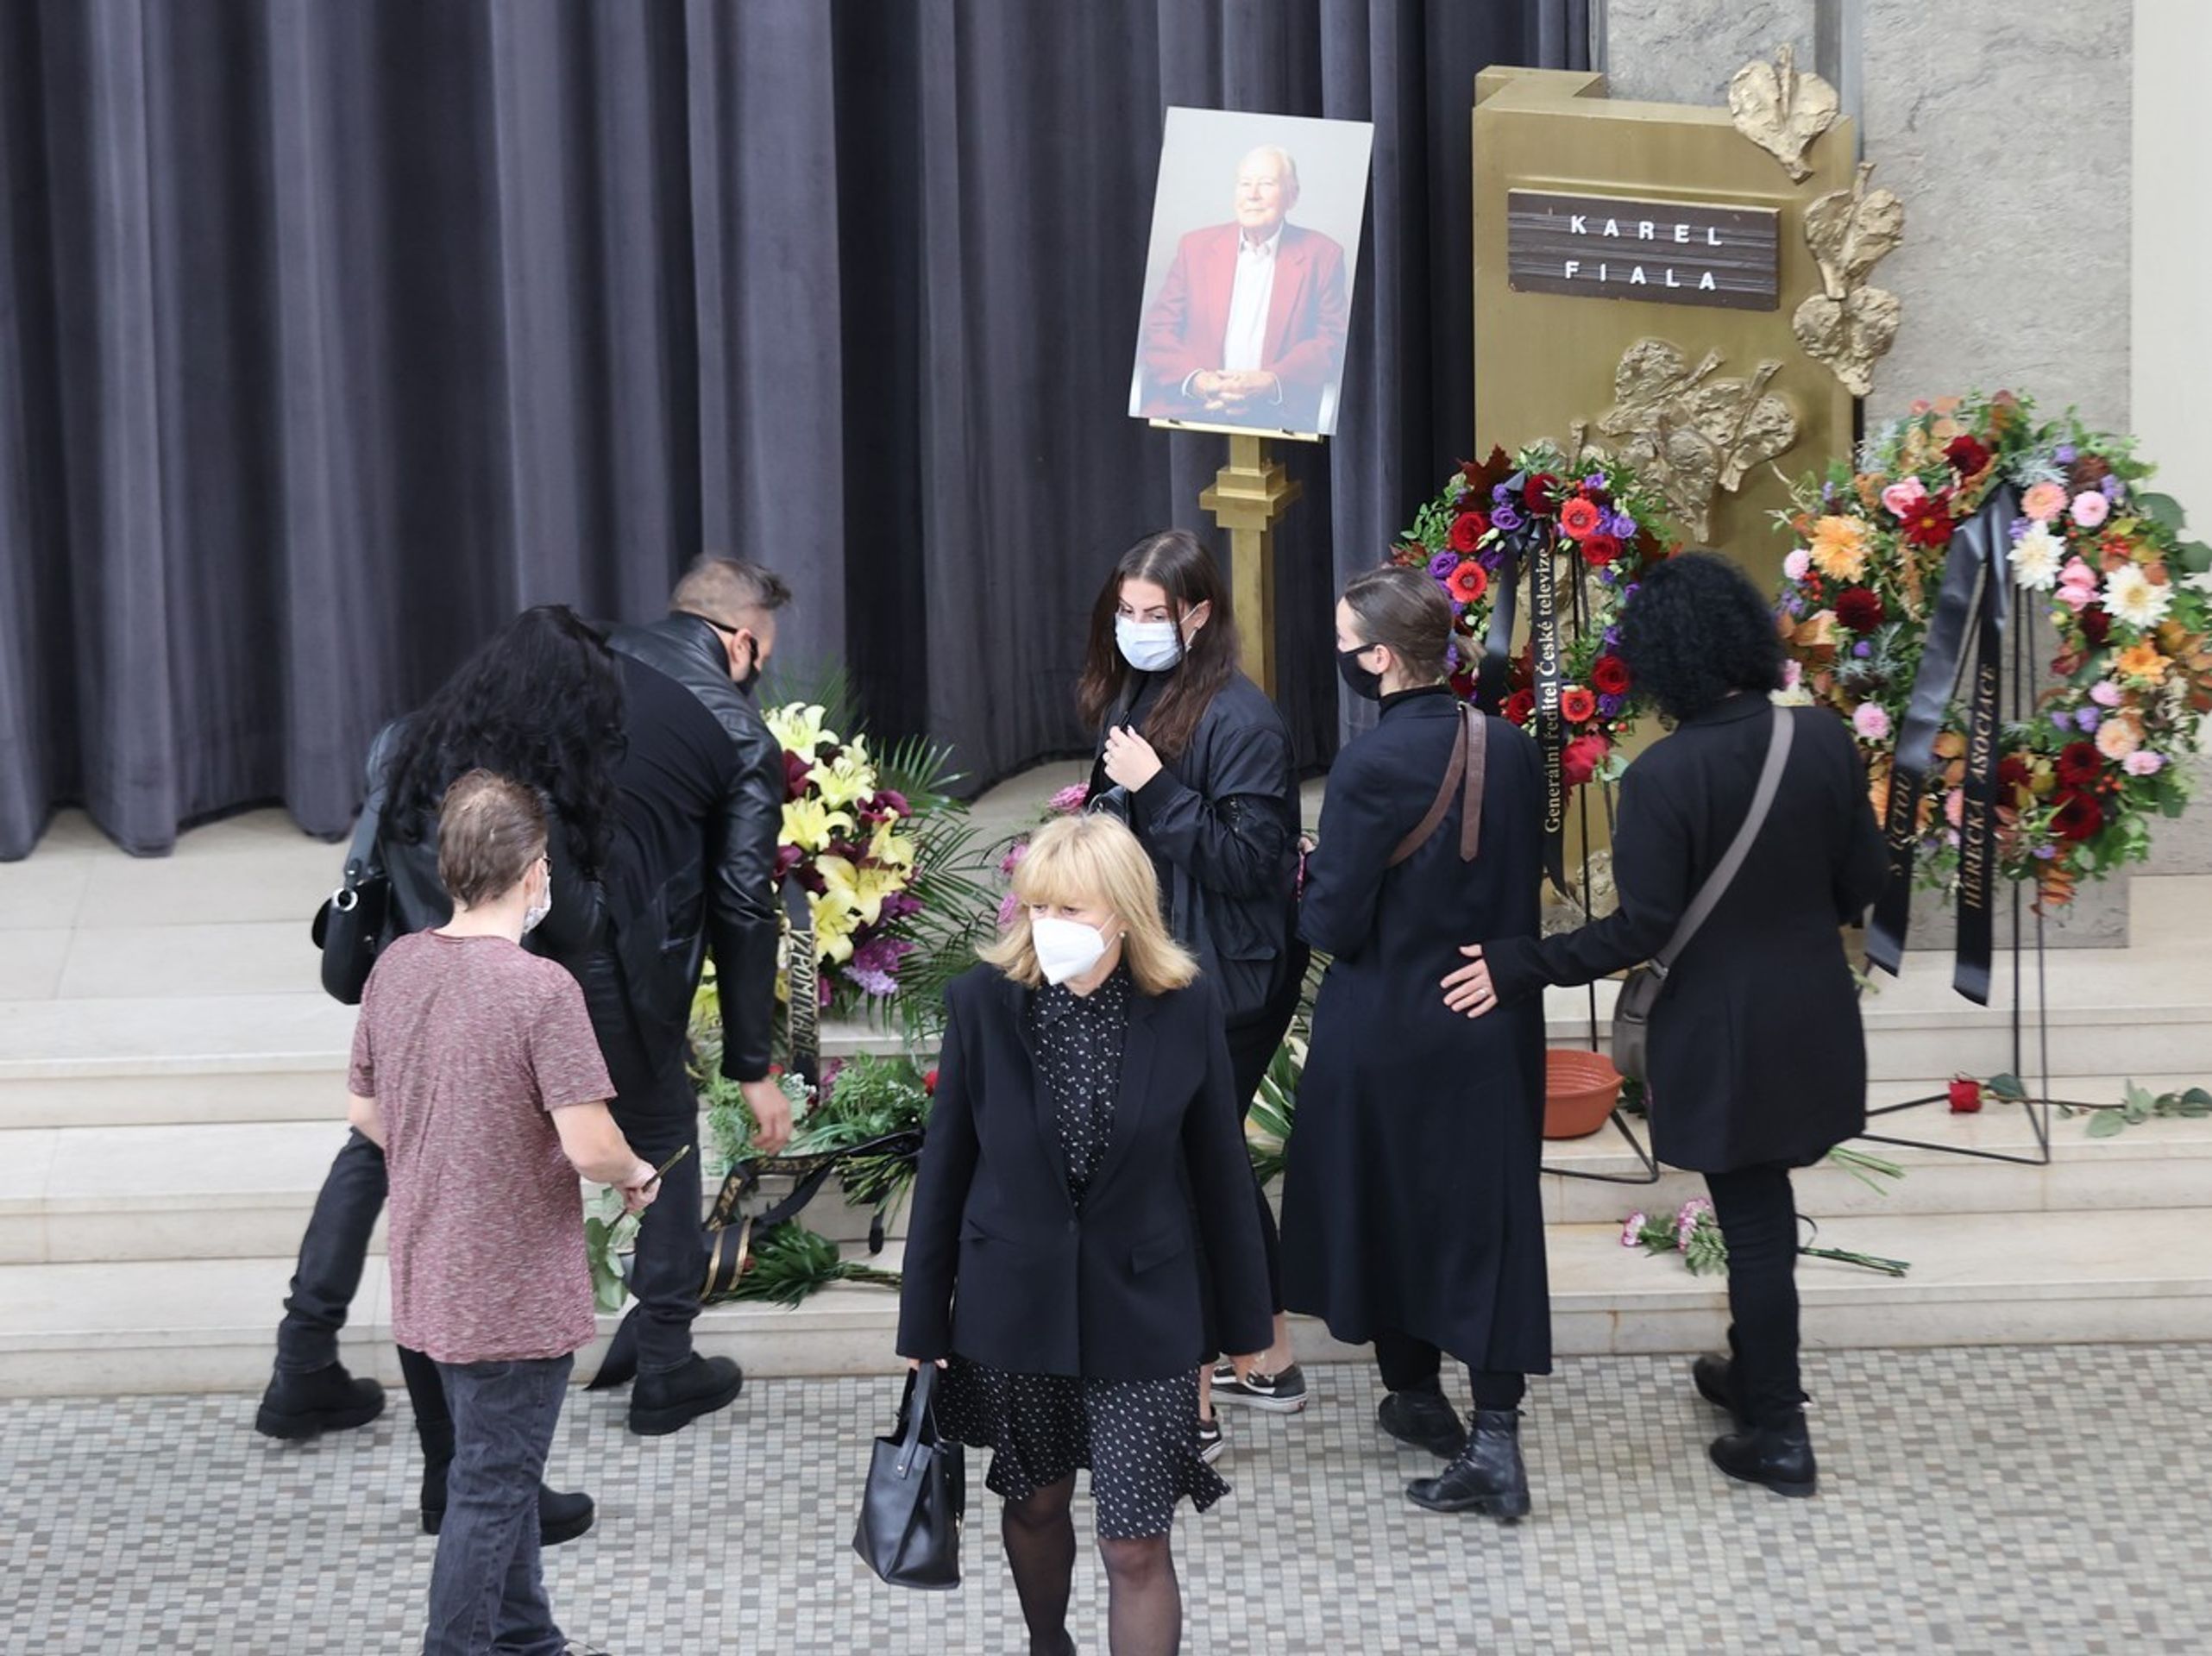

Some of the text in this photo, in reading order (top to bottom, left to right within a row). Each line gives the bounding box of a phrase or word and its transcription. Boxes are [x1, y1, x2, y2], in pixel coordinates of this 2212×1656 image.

[1570, 215, 1722, 246] KAREL
[1565, 260, 1716, 290] FIALA
[1533, 548, 1562, 834] Generální ředitel České televize
[1970, 662, 1996, 783] ASOCIACE
